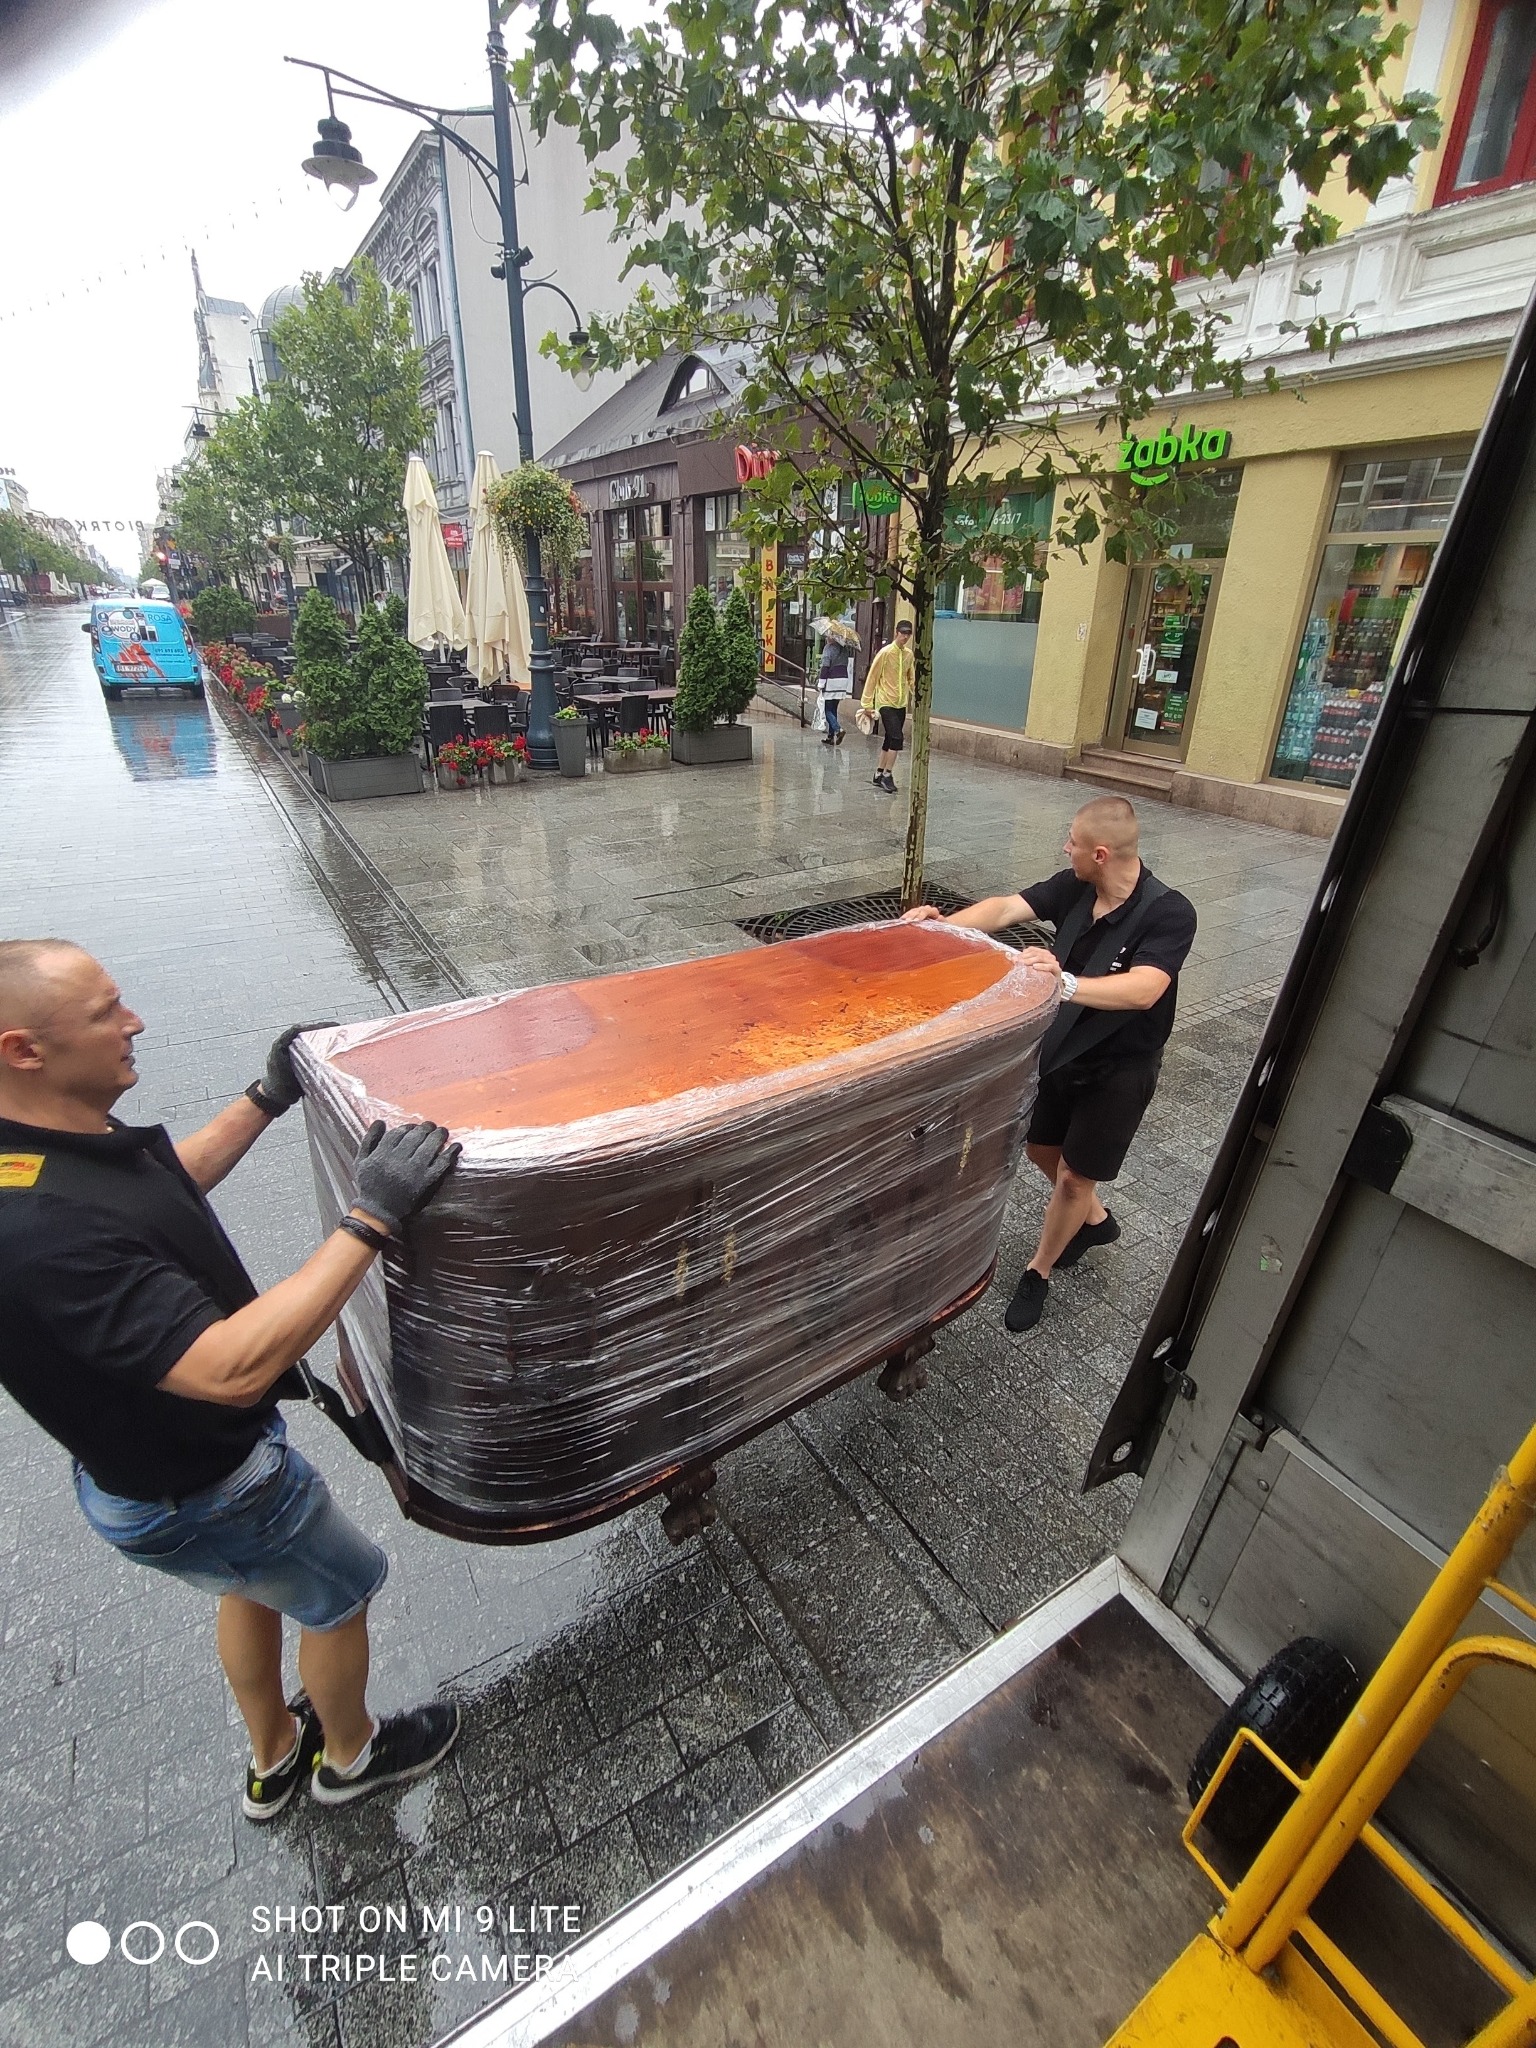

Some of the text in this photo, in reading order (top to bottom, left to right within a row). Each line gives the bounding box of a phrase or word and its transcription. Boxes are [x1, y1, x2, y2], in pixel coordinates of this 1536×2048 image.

[1117, 423, 1229, 471] żabka
[609, 477, 631, 503] Club
[147, 613, 172, 622] ROSA
[765, 540, 775, 664] BNŻKA
